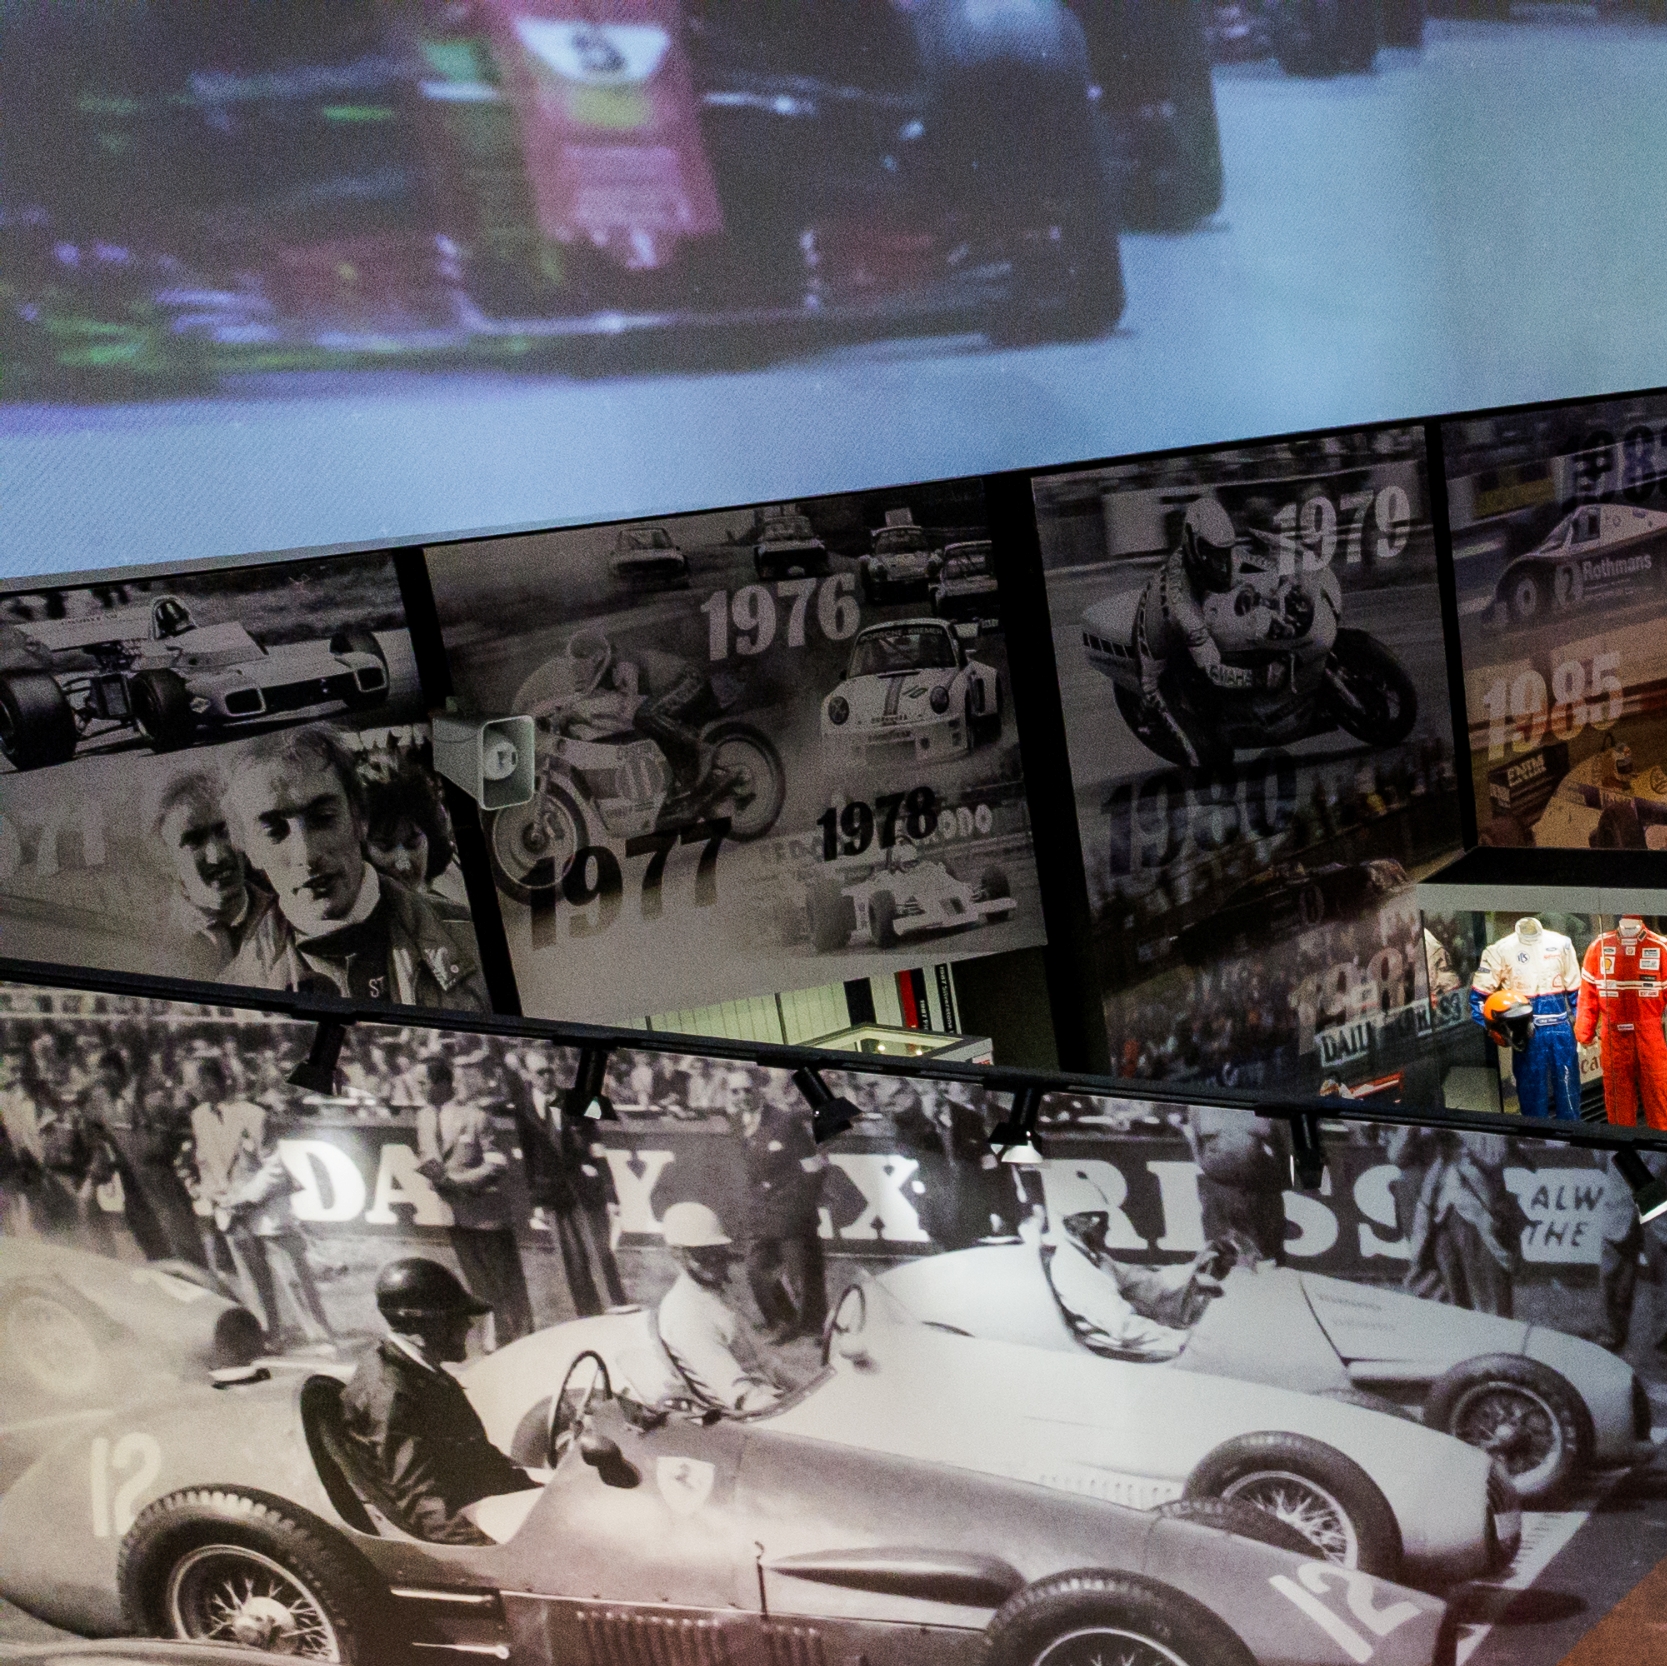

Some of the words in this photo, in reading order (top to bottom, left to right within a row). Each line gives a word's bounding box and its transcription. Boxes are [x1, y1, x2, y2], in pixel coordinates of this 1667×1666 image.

[1271, 485, 1411, 577] 1979
[1583, 552, 1652, 582] Rothmans
[701, 571, 861, 661] 1976
[1483, 652, 1625, 760] 1985
[816, 785, 938, 861] 1978
[527, 818, 732, 948] 1977
[1524, 1219, 1587, 1245] THE
[90, 1432, 160, 1537] 12
[1270, 1559, 1424, 1664] 12
